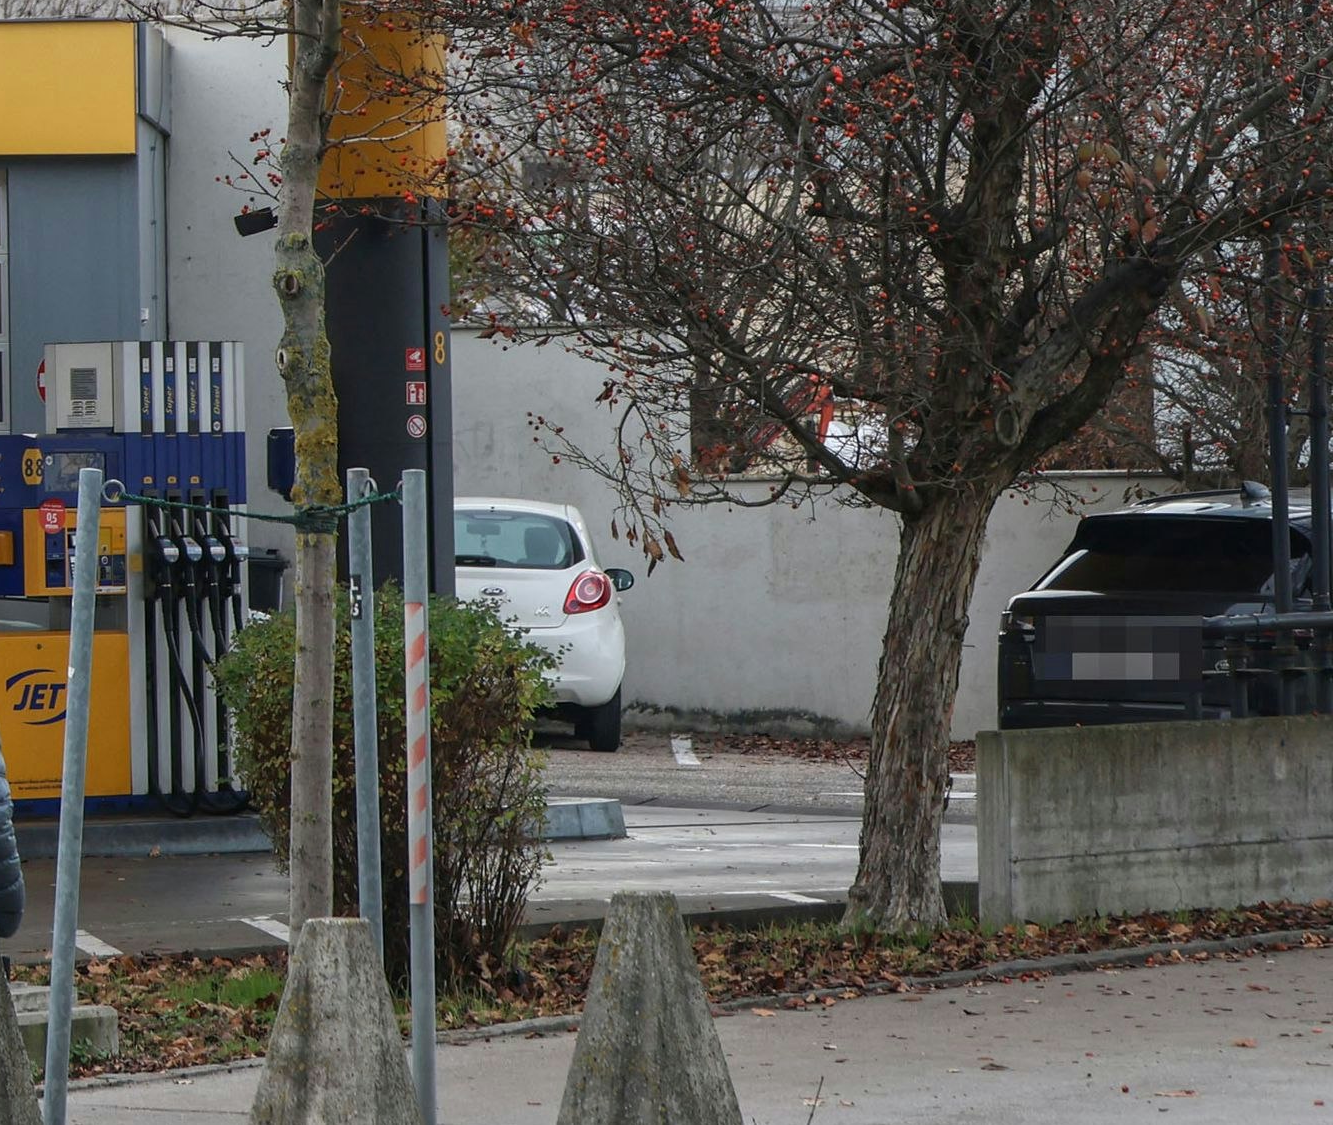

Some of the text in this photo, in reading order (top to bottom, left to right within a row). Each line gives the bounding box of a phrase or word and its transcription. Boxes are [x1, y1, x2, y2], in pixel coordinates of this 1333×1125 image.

[434, 330, 446, 365] 8
[141, 386, 151, 415] Super
[165, 386, 175, 415] Super
[213, 385, 221, 415] Diesel
[25, 458, 33, 477] 8
[13, 683, 66, 711] JET
